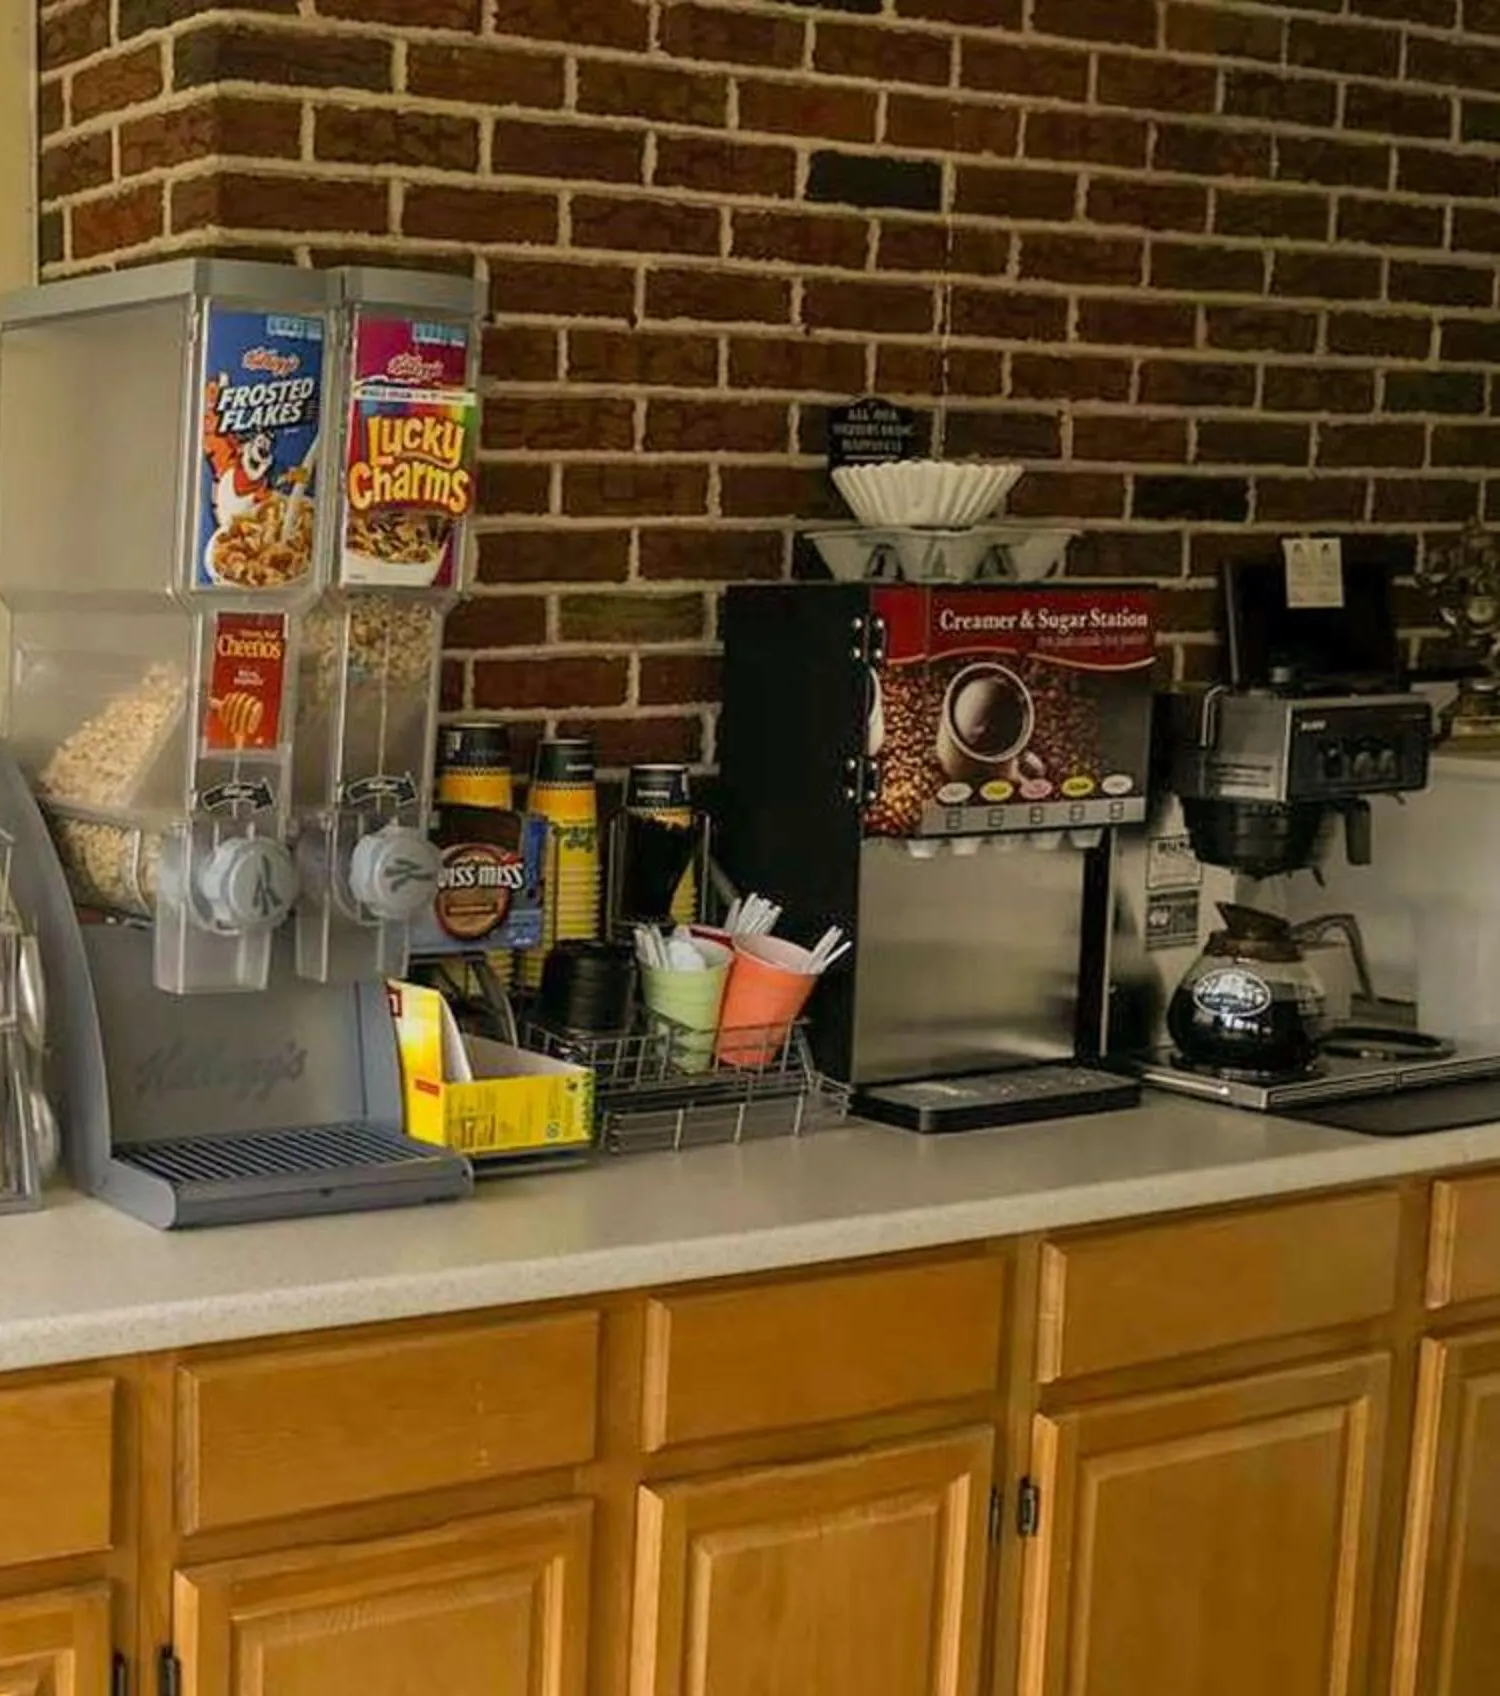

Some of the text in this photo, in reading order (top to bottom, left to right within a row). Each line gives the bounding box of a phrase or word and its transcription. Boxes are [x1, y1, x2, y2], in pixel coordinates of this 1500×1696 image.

[217, 377, 314, 411] FROSTED
[219, 400, 303, 432] FLAKES
[367, 415, 465, 470] Lucky
[350, 461, 469, 513] Charms
[940, 606, 1148, 634] Creamer & Sugar Station
[218, 634, 281, 659] Cheerios
